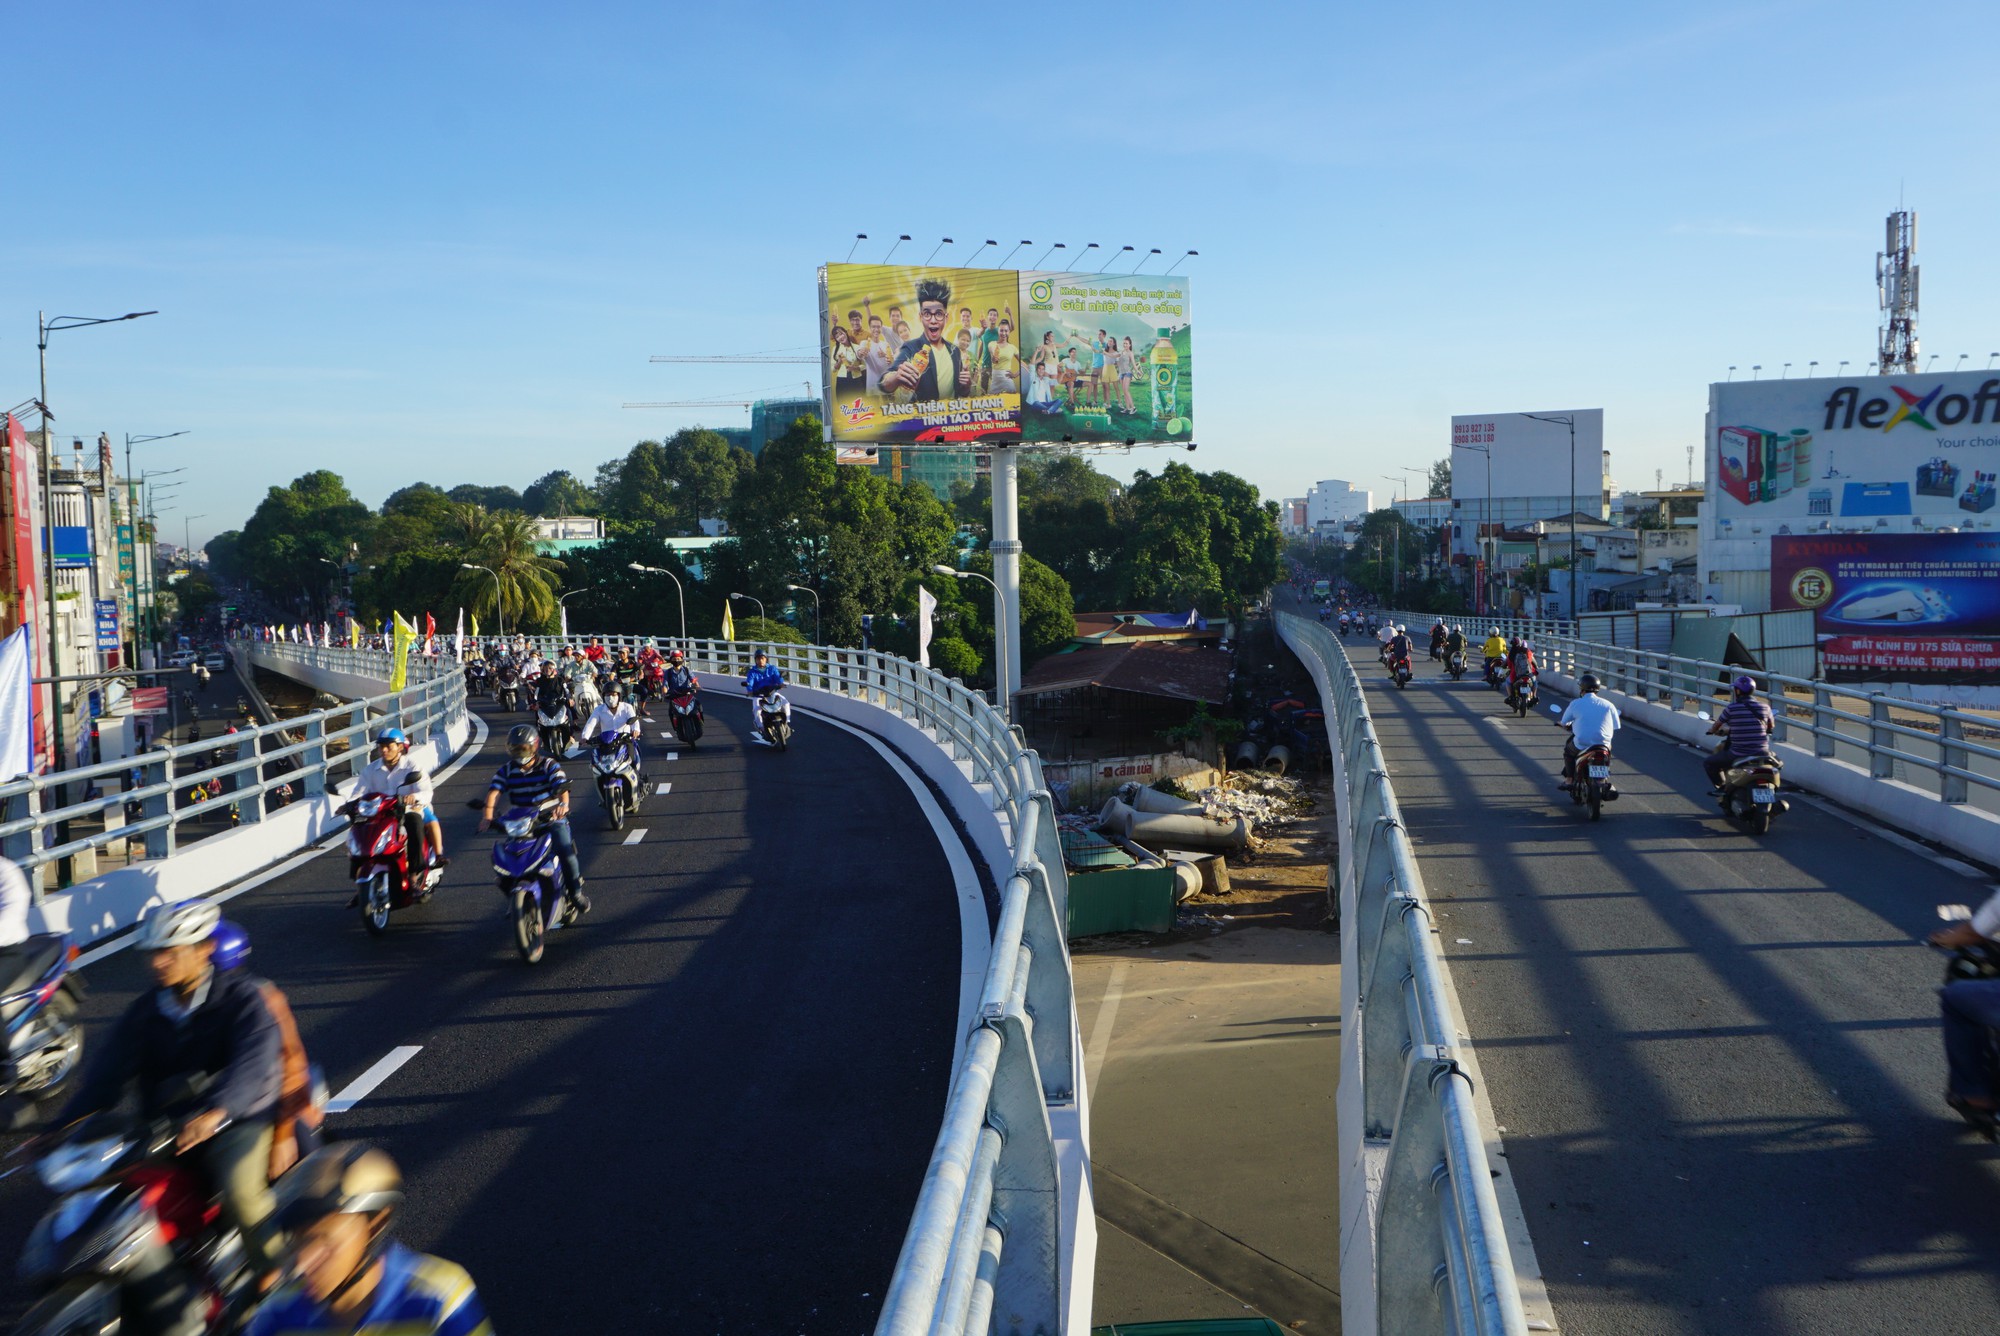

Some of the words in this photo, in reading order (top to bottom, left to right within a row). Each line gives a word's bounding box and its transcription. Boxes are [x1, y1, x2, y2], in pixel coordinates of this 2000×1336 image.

[1060, 286, 1087, 298] Không
[1089, 288, 1098, 296] lo
[1099, 288, 1121, 299] căng
[1060, 298, 1085, 311] Giải
[1089, 300, 1118, 315] nhiệt
[1121, 301, 1151, 316] cuộc
[1154, 300, 1182, 317] sống
[840, 403, 870, 416] Number
[881, 402, 914, 416] TĂNG
[916, 399, 946, 413] THÊM
[1455, 424, 1469, 433] 0913
[1470, 424, 1482, 433] 927
[1484, 423, 1495, 432] 135
[1483, 433, 1495, 442] 180
[1937, 437, 1966, 449] Your
[1787, 542, 1869, 556] KYMDAN
[1802, 582, 1821, 598] 15
[98, 638, 118, 646] KHOA
[1875, 640, 1901, 651] KÍNH
[1903, 642, 1917, 651] BV
[1920, 643, 1938, 651] 175
[1826, 653, 1859, 663] THANH
[1861, 652, 1873, 664] LÝ
[1875, 653, 1894, 665] HẾT
